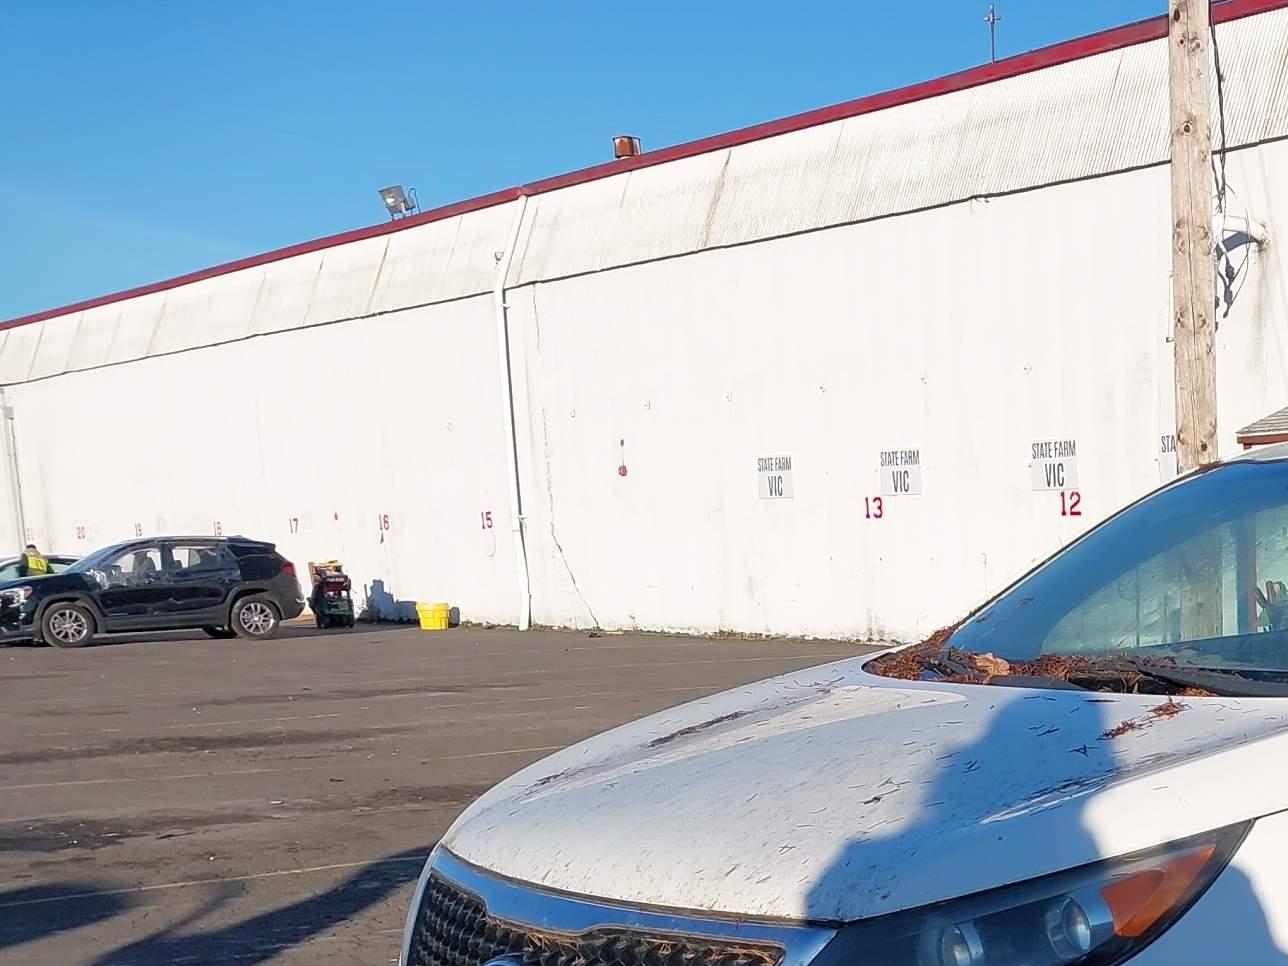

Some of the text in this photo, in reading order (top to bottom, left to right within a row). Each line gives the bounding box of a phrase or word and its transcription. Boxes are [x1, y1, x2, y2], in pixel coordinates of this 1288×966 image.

[880, 449, 920, 467] STATE FARM
[1032, 439, 1076, 459] STATE FARM
[757, 456, 792, 473] STATE FARM
[892, 470, 910, 493] VIC
[1045, 462, 1065, 488] VIC
[768, 475, 783, 496] VIC
[864, 496, 883, 519] 13
[1060, 491, 1082, 516] 12
[134, 522, 143, 537] 19
[289, 518, 299, 534] 17
[378, 514, 391, 531] 16
[480, 511, 493, 530] 15
[76, 525, 86, 539] 20
